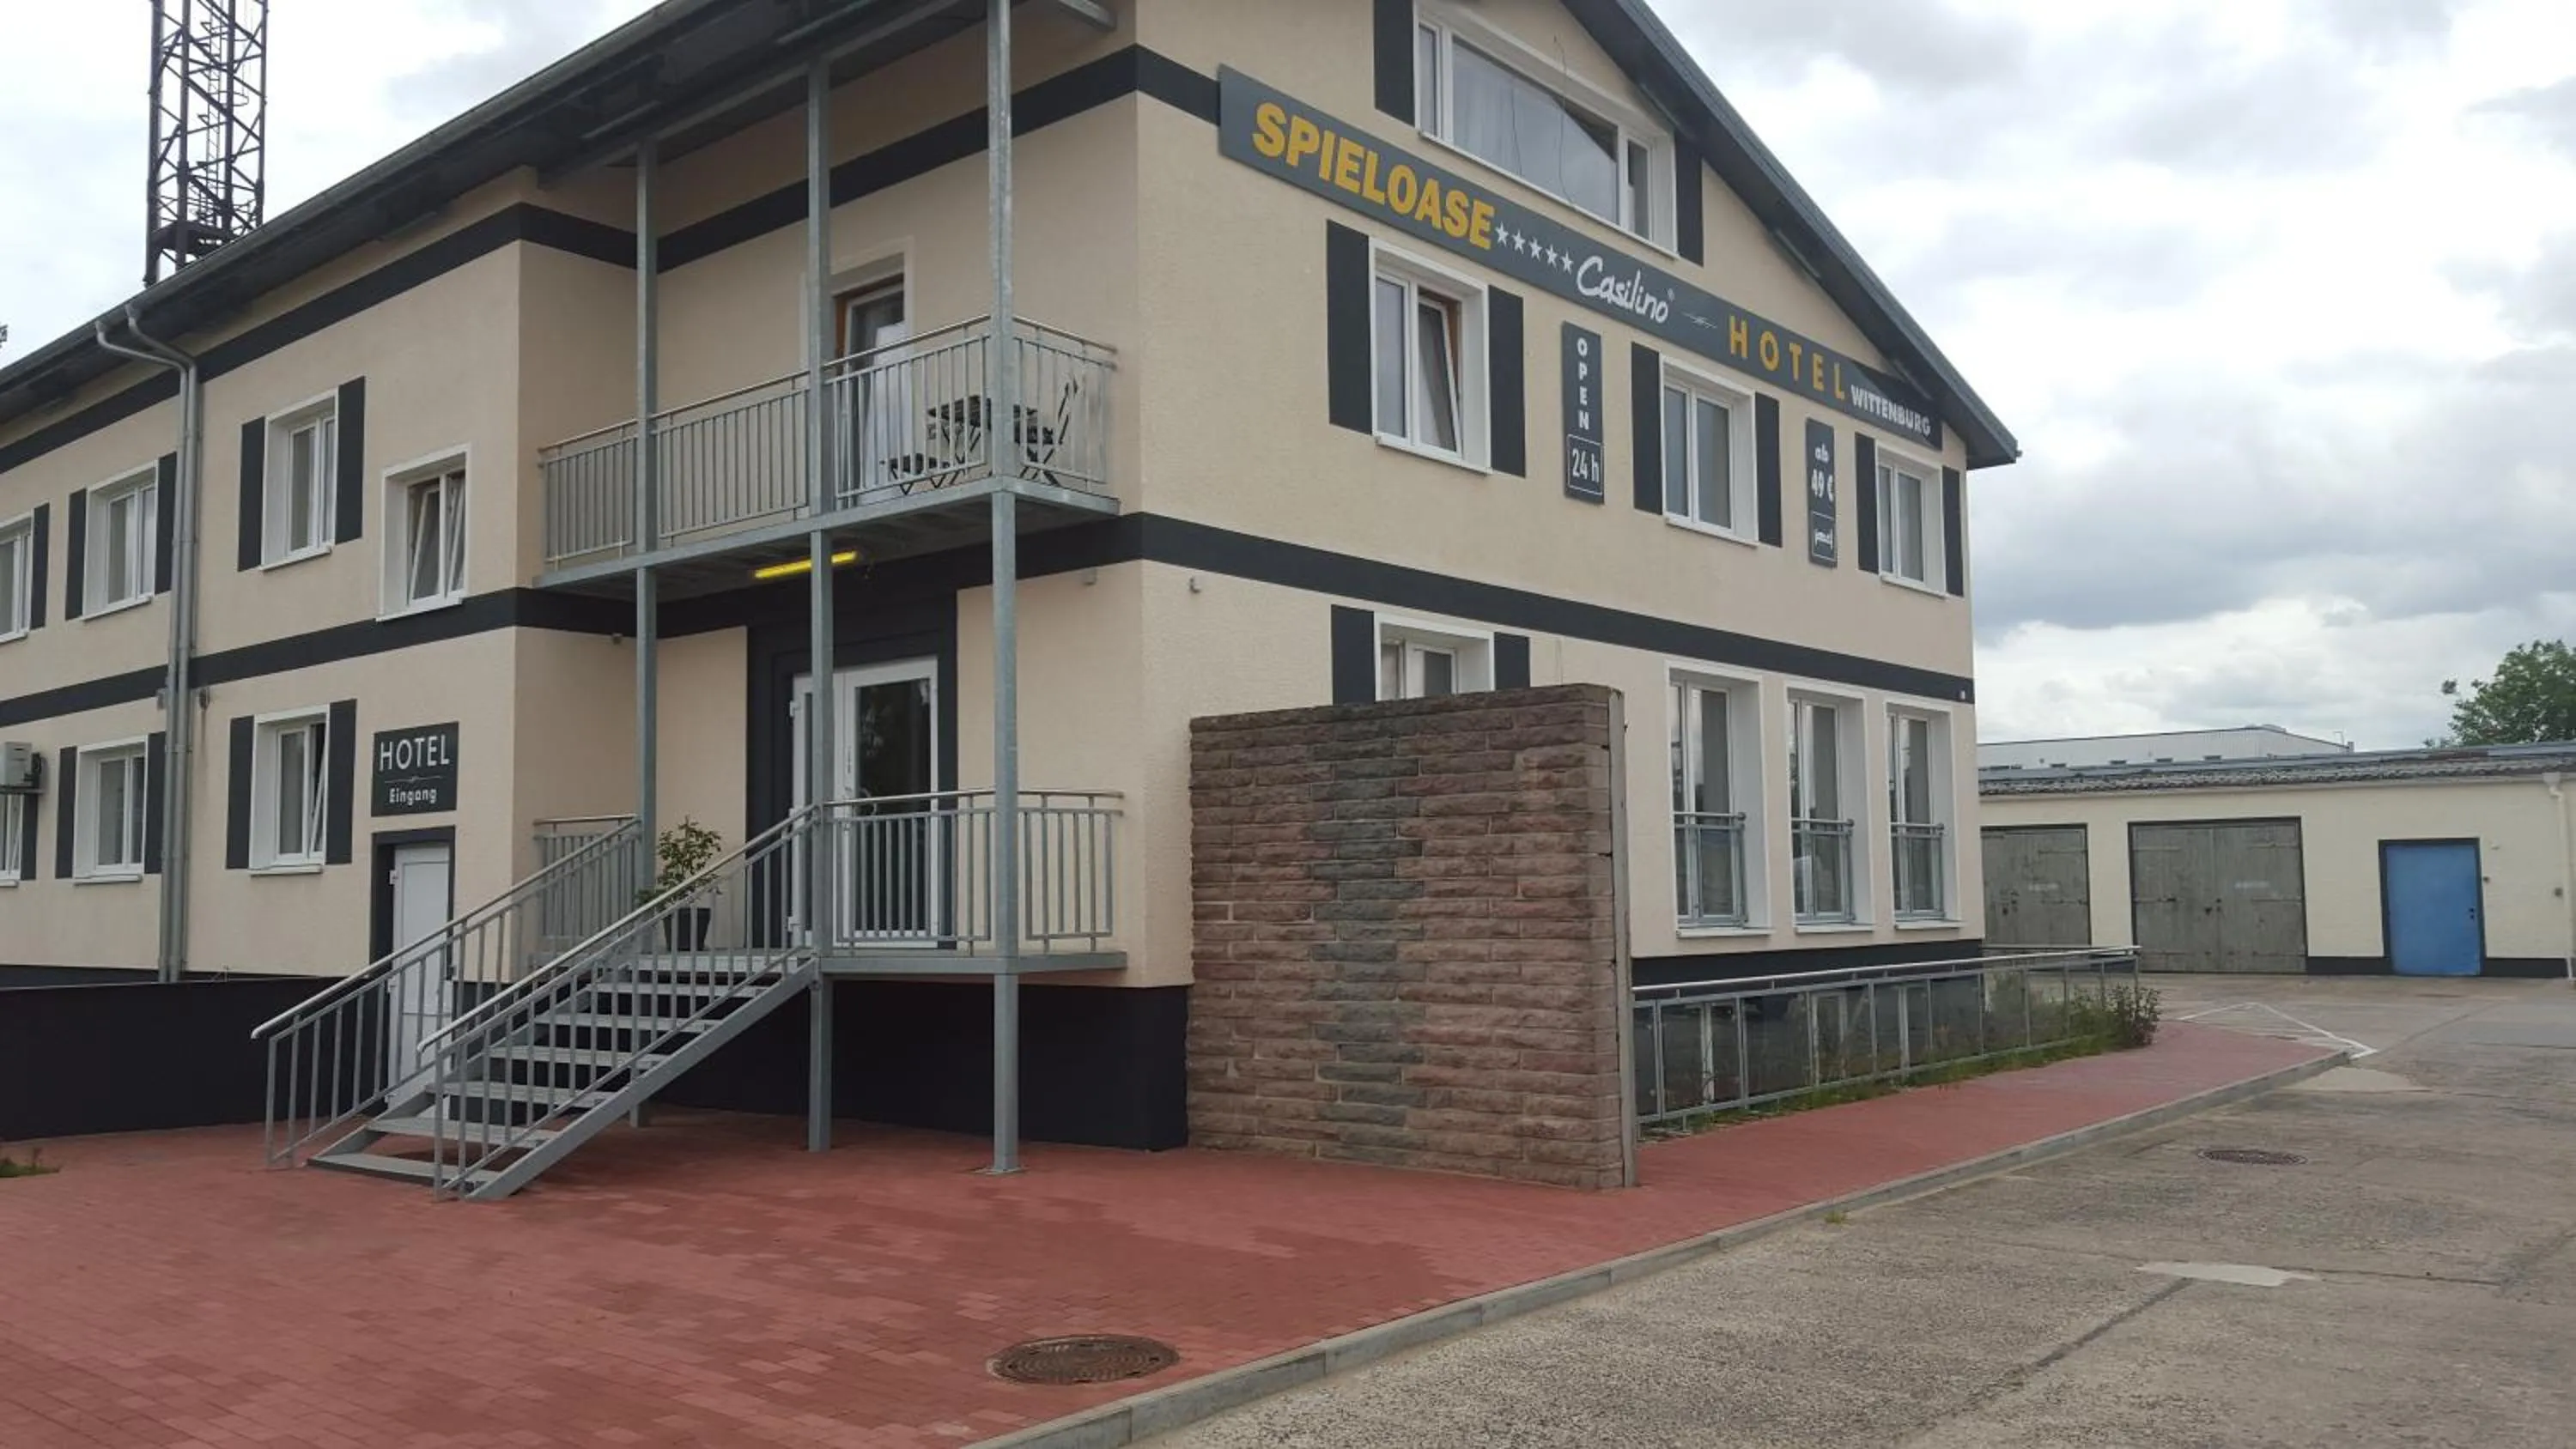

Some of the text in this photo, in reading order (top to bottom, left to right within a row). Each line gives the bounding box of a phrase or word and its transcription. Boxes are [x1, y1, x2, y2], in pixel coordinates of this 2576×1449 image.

[1252, 101, 1496, 250] SPIELOASE
[1577, 256, 1668, 324] Casilino
[1577, 337, 1589, 430] OPEN
[1729, 315, 1930, 435] HOTEL WITTENBURG
[1572, 448, 1600, 483] 24 h
[1814, 443, 1829, 464] ab
[380, 734, 450, 772] HOTEL
[389, 788, 437, 806] Eingang
